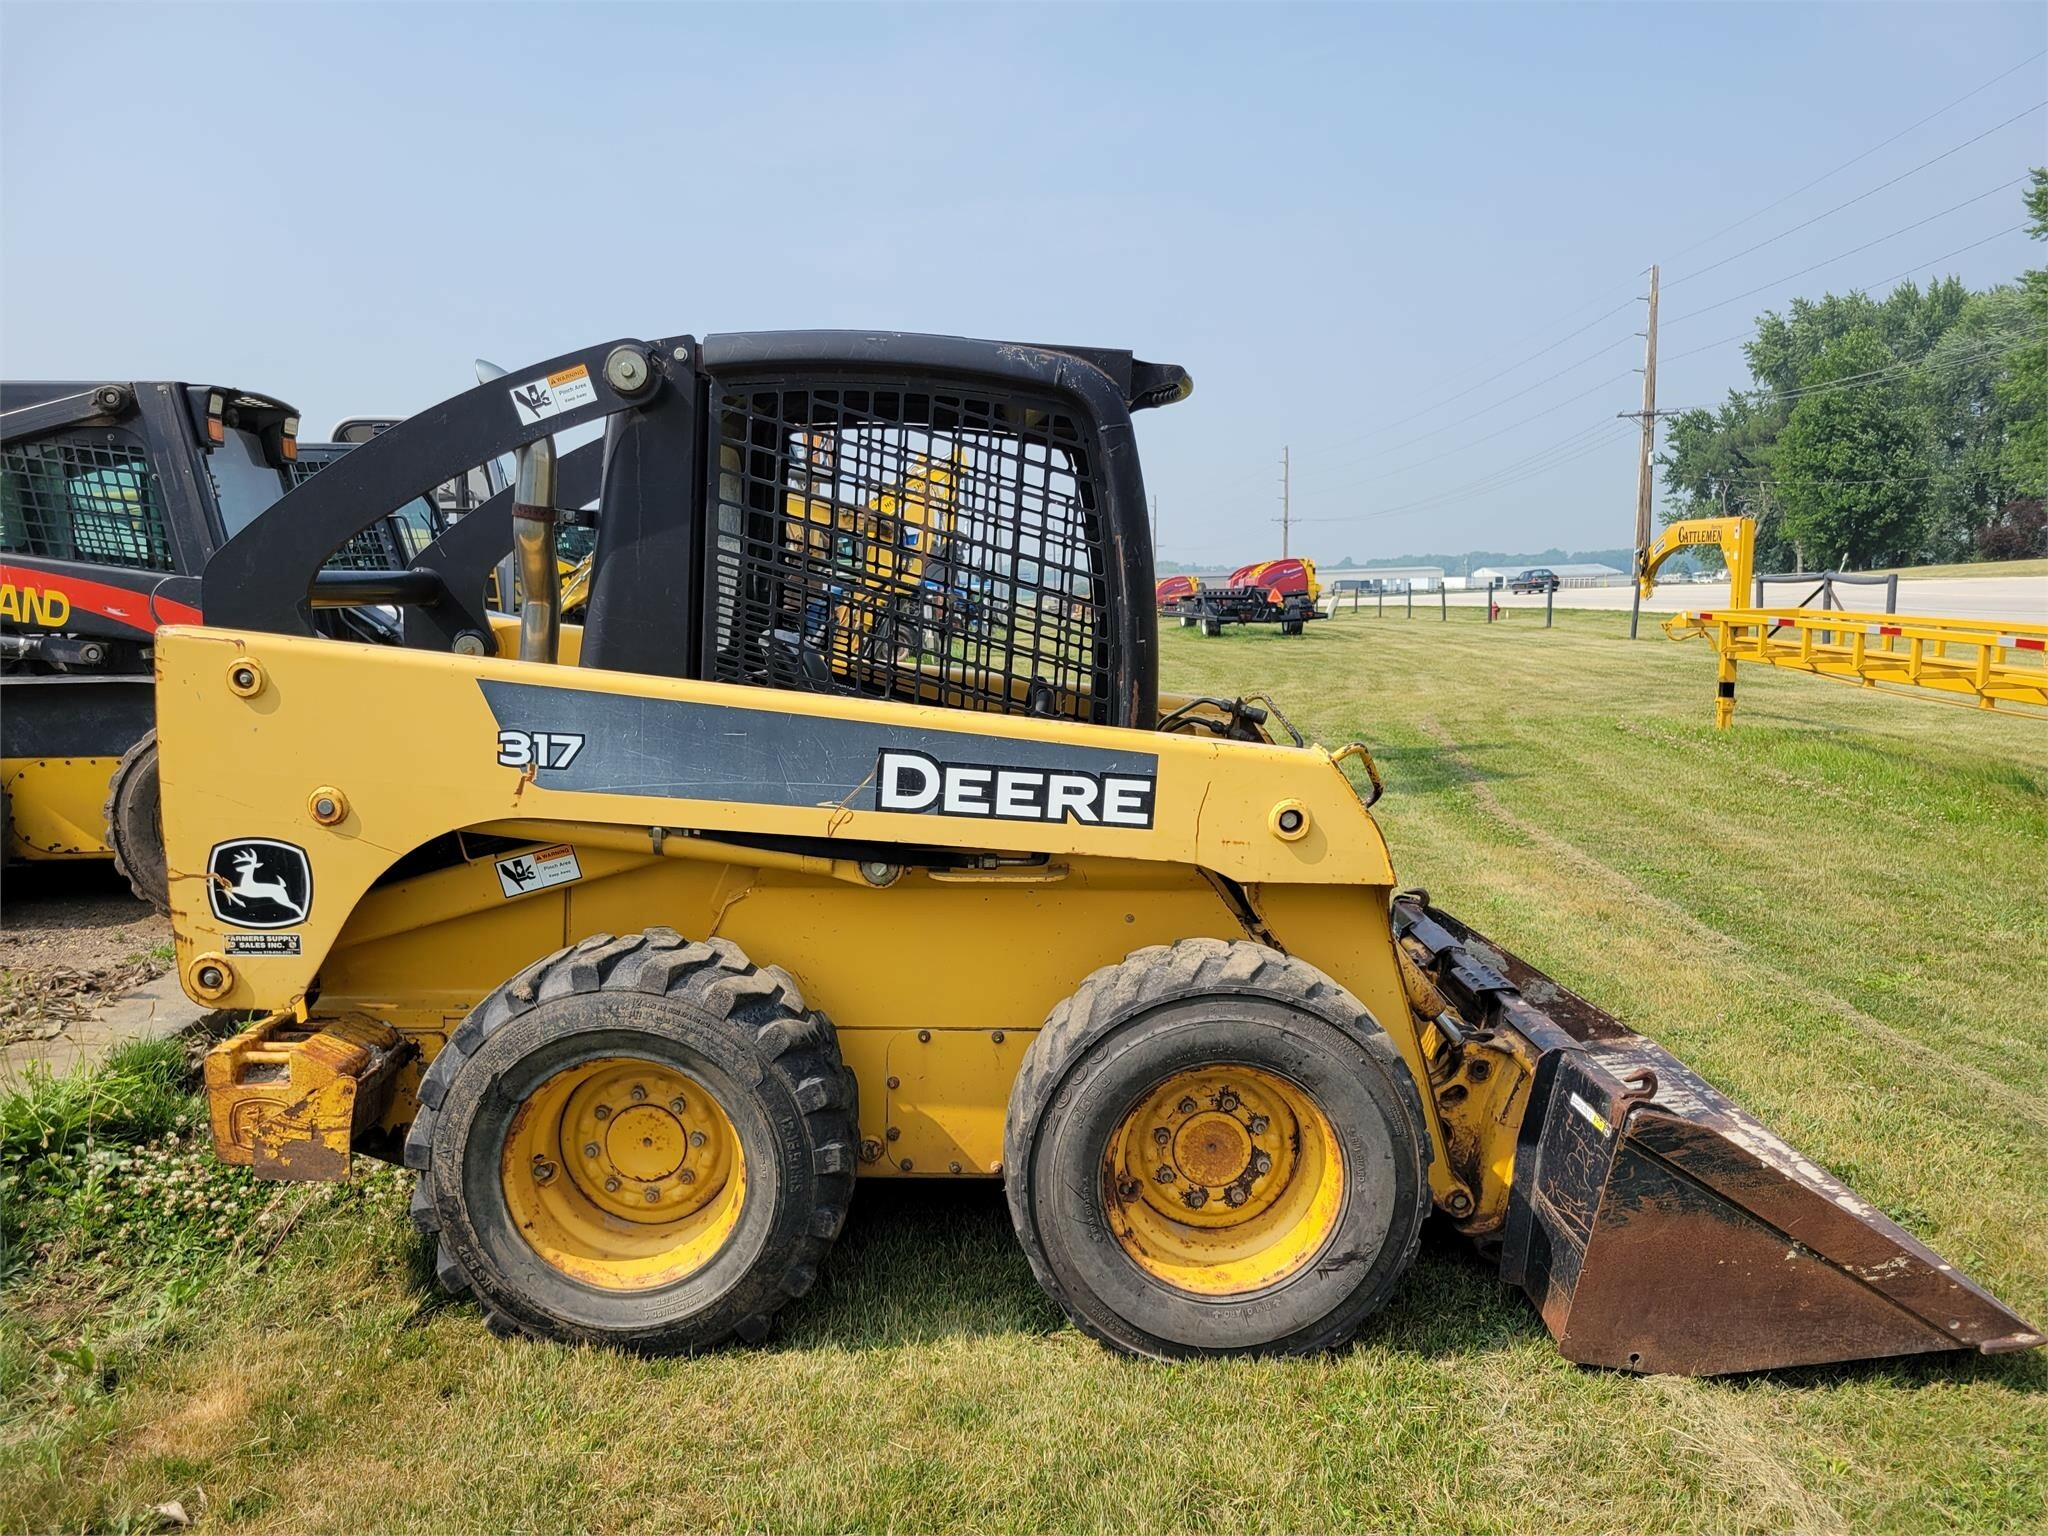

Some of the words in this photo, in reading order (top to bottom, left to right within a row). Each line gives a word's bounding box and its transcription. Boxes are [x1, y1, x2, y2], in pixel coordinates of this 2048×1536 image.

[556, 369, 584, 382] WARNING
[1678, 526, 1723, 543] CATTLEMEN
[498, 731, 584, 769] 317
[880, 752, 1152, 825] DEERE
[543, 848, 570, 858] WARNING
